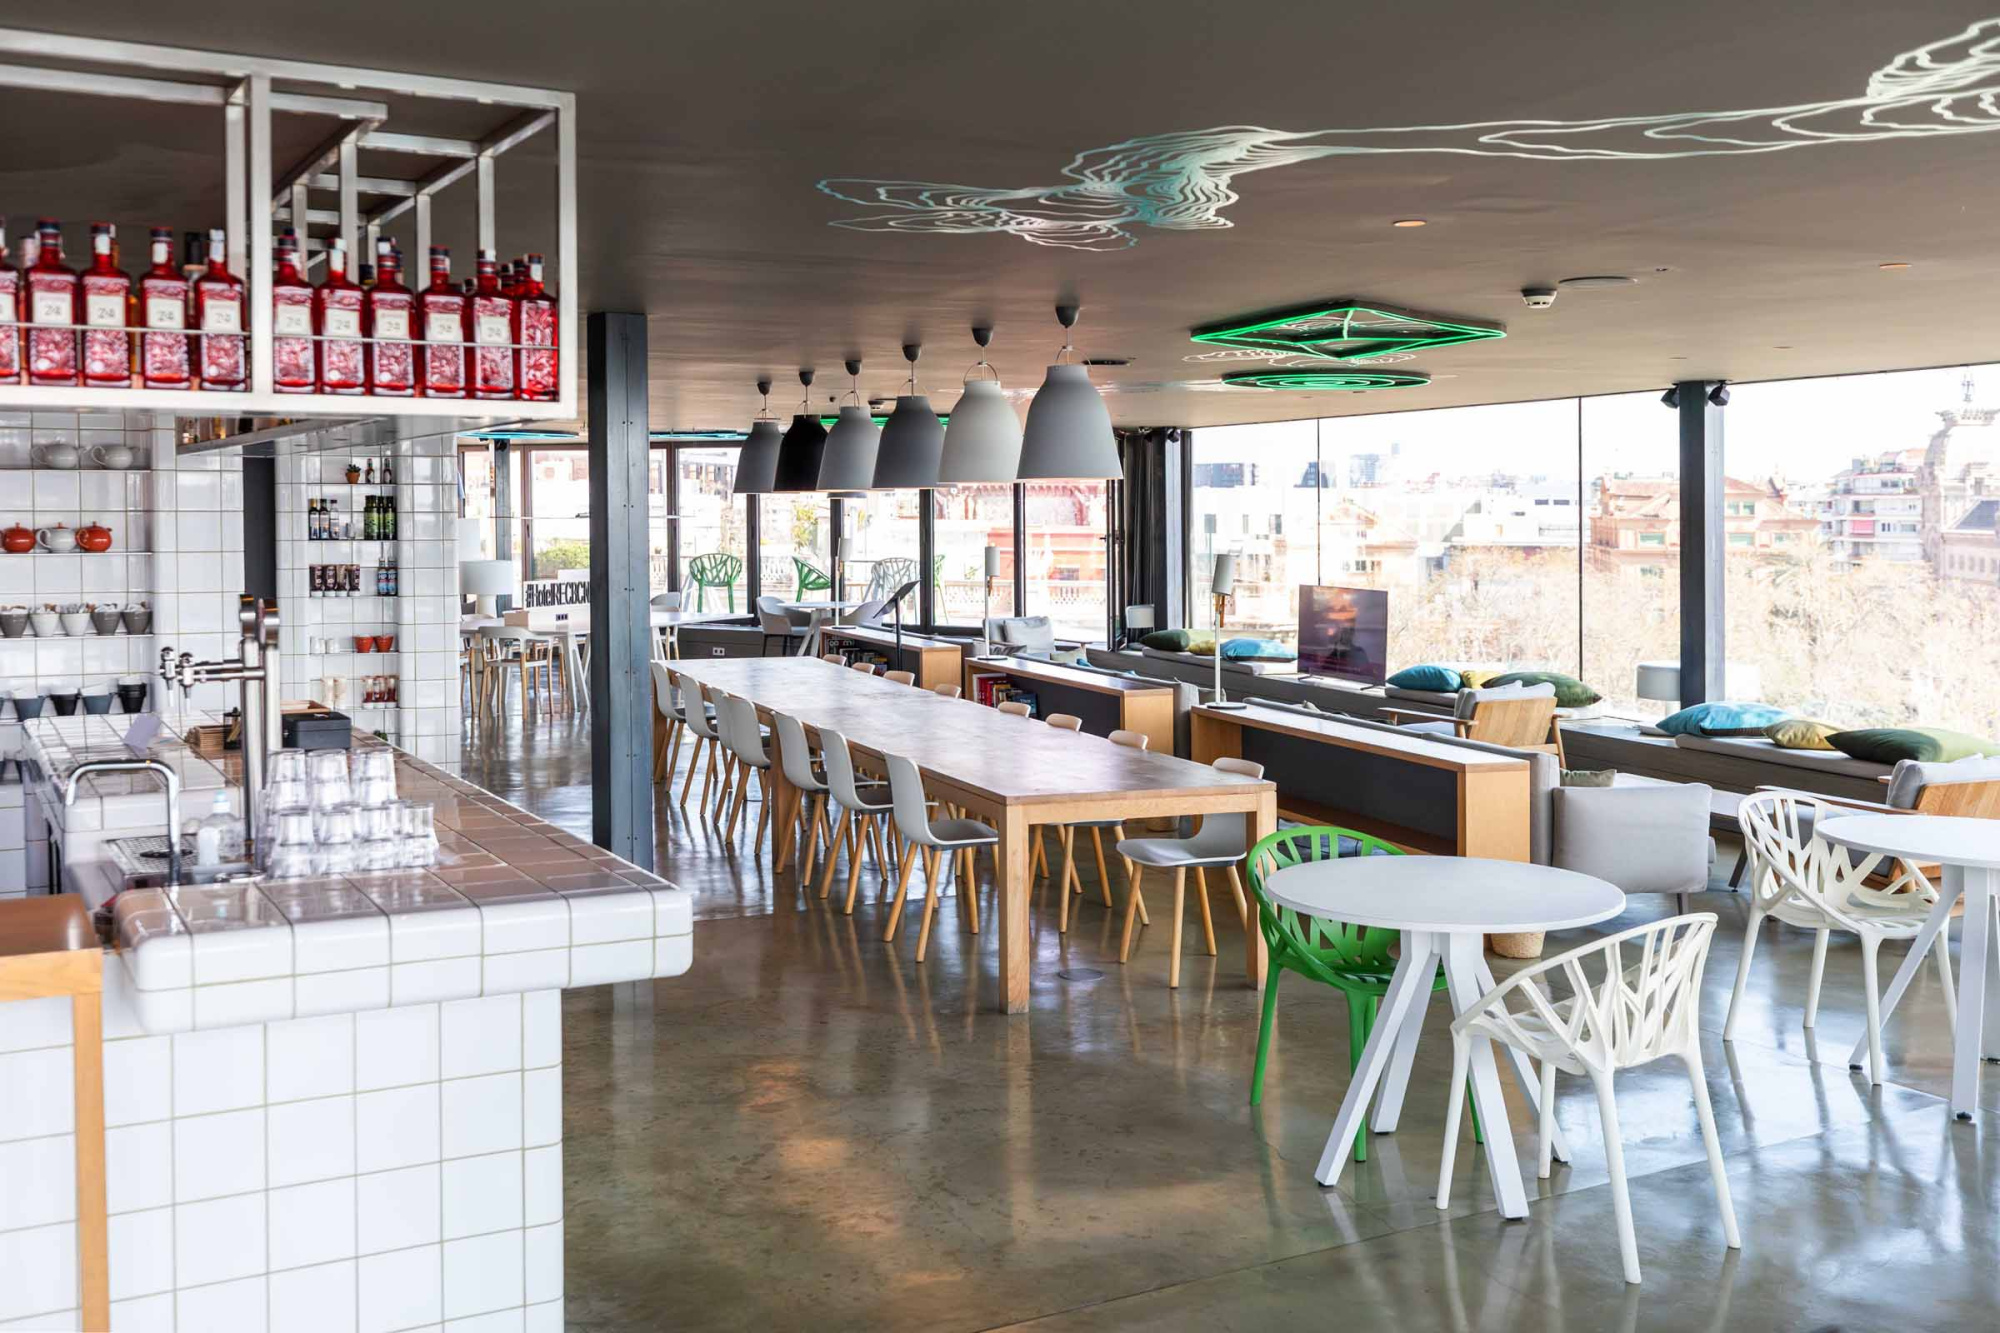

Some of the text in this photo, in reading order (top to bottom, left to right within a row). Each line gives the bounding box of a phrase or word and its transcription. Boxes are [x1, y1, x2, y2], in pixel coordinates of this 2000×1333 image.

[45, 304, 61, 316] 24
[98, 307, 114, 319] 24
[157, 311, 174, 321] 24
[525, 581, 590, 606] #HotelRECBCN
